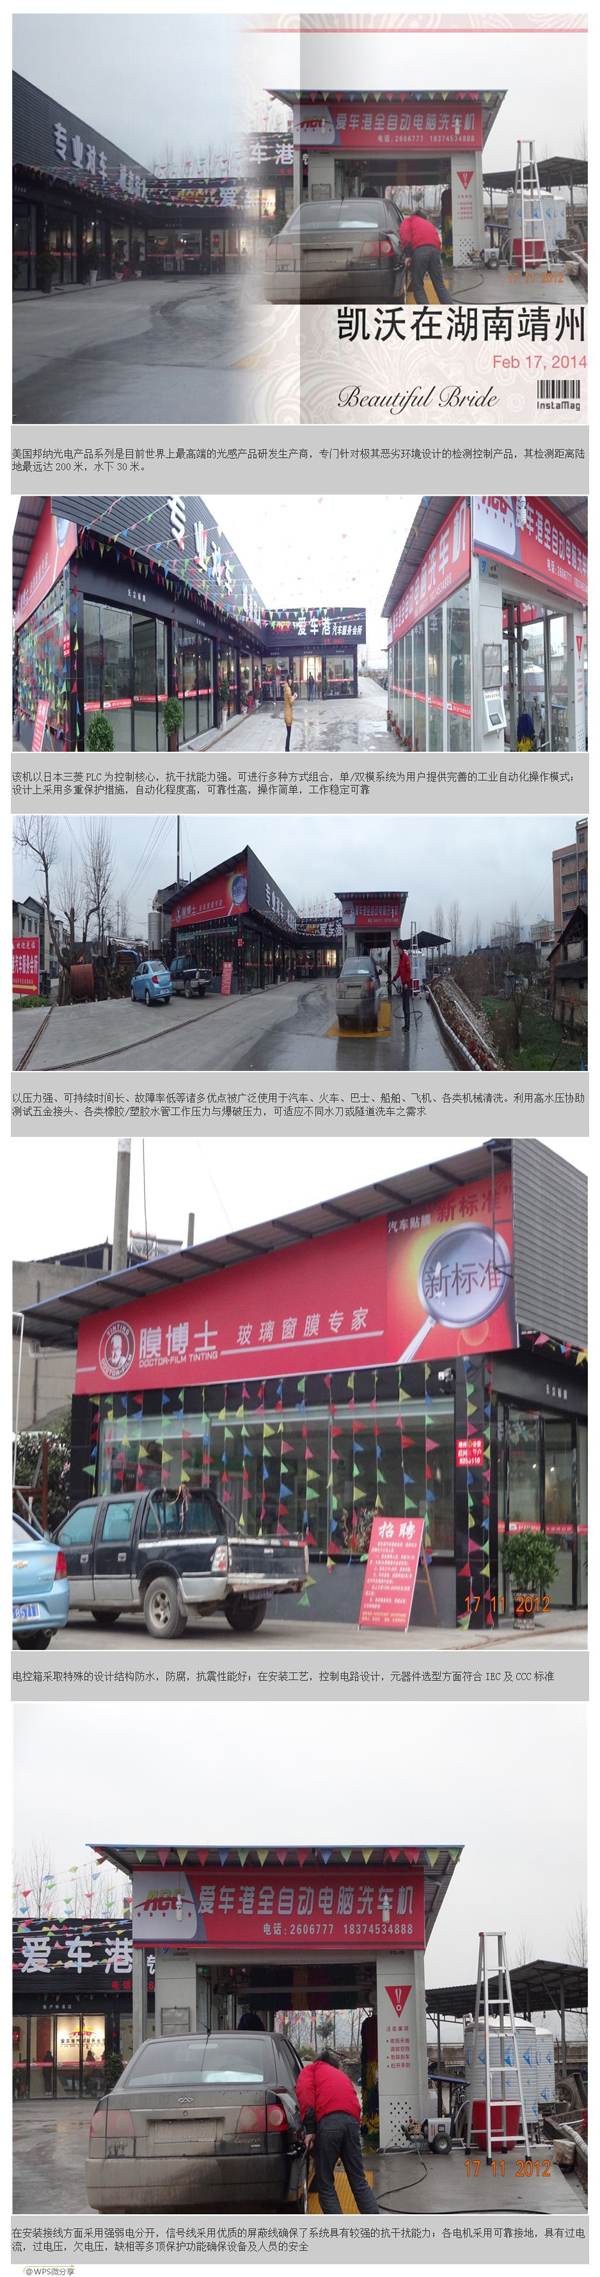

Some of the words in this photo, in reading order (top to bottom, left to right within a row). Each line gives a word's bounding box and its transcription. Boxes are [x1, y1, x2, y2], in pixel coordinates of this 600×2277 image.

[336, 113, 475, 131] 爱车港全自动电脑洗车机
[424, 1259, 503, 1299] 新标准
[139, 1320, 218, 1359] 膜博士
[237, 1307, 369, 1346] 玻璃窗膜专家
[139, 1355, 187, 1368] DOCTOR-FILM
[189, 1351, 218, 1362] TINTING
[378, 1521, 415, 1540] 招聘
[197, 1885, 414, 1915] 爱车港全自动电脑洗车机
[343, 1923, 414, 1935] 18374534888
[20, 1935, 133, 1974] 爱车港
